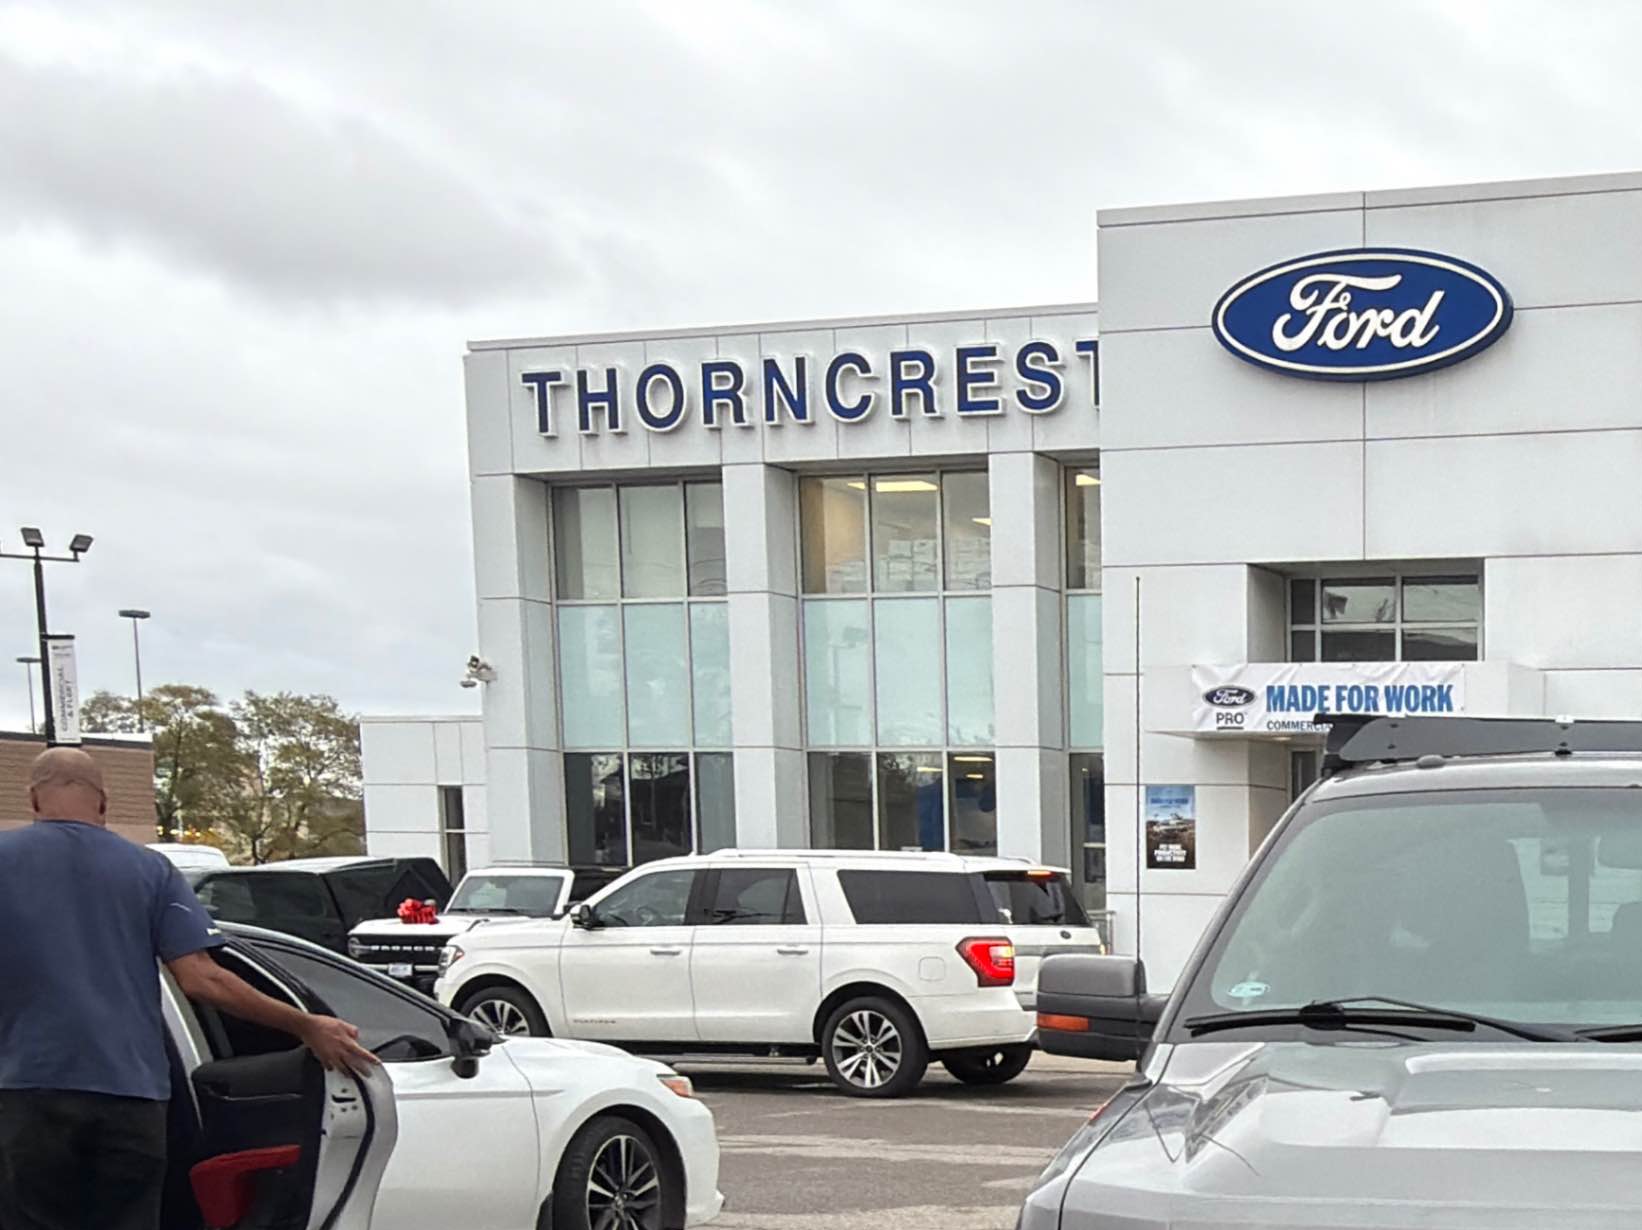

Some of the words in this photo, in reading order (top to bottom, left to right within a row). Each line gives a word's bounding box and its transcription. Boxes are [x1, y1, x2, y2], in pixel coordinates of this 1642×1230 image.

[1272, 273, 1445, 351] Ford
[1213, 687, 1247, 705] Ford
[1266, 685, 1330, 713] MADE
[1335, 685, 1379, 712] FOR
[1384, 684, 1453, 712] WORK
[1216, 712, 1244, 724] PRO
